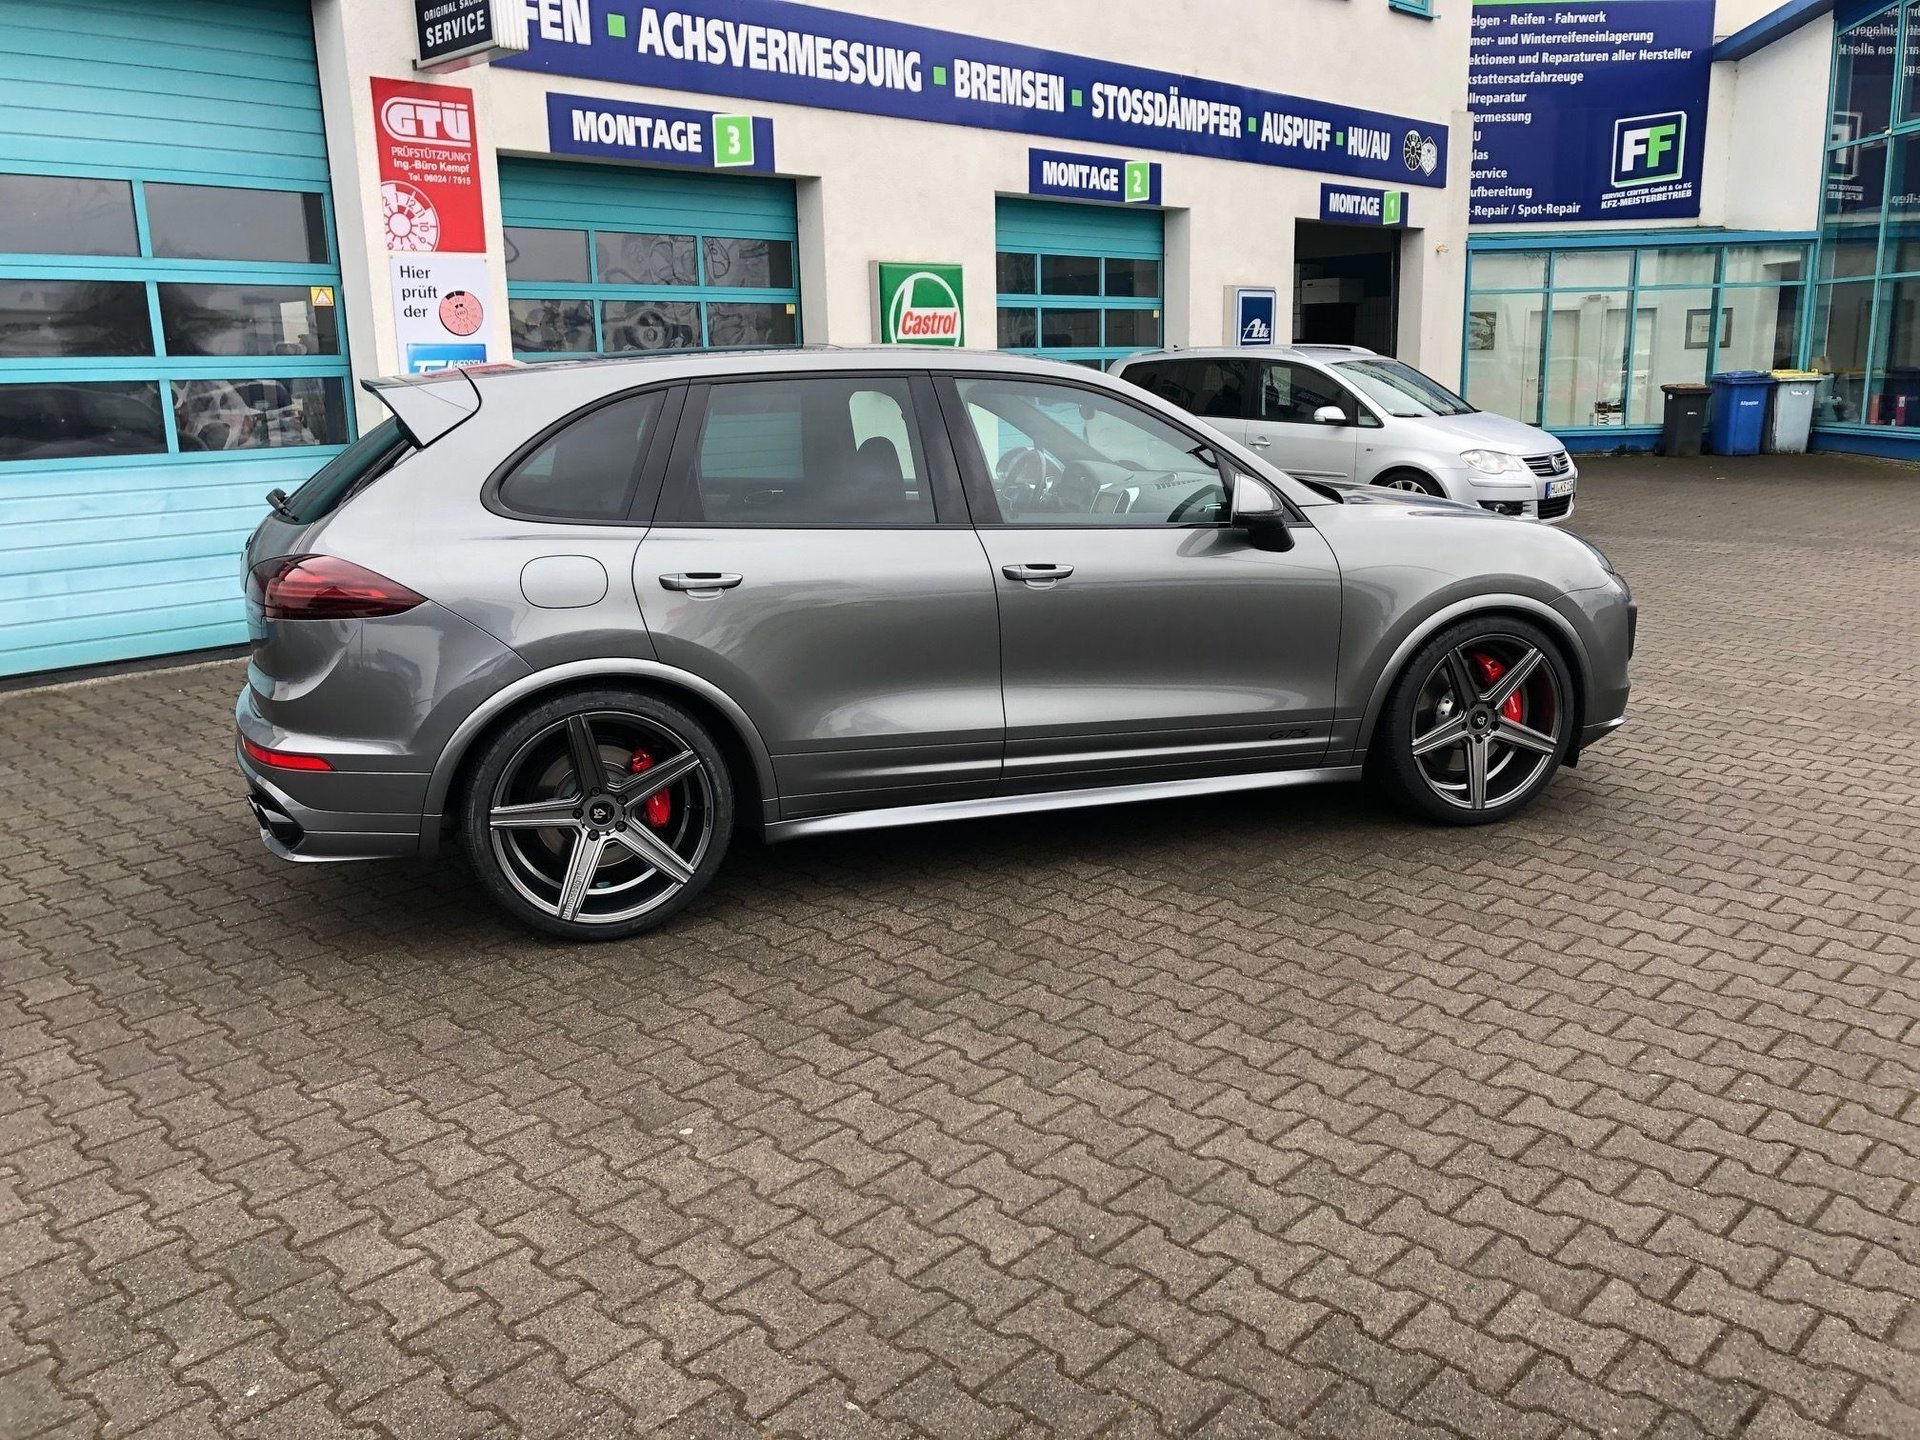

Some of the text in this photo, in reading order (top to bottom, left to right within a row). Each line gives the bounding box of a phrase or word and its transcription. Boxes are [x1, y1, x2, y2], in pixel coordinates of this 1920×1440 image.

[424, 0, 482, 22] ORIGINAL SAC
[1510, 13, 1545, 25] Reifen
[1555, 11, 1606, 24] Fahrwerk
[426, 10, 486, 48] SERVICE
[1498, 33, 1518, 45] und
[1521, 30, 1654, 45] Winterreifeneinlagerung
[1518, 52, 1539, 64] und
[1542, 50, 1609, 66] Reparaturen
[1612, 49, 1637, 62] aller
[1639, 48, 1692, 61] Hersteller
[638, 7, 922, 93] ACHSVERMESSUNG
[954, 58, 1064, 112] BREMSEN
[1092, 82, 1242, 138] STOSSDÄMPFER
[1261, 111, 1331, 152] AUSPUFF
[1348, 126, 1390, 161] HU/AU
[1468, 92, 1527, 106] llreparatur
[386, 100, 471, 142] GTÜ
[1474, 112, 1532, 124] ermessung
[572, 109, 740, 155] MONTAGE 3
[1472, 131, 1482, 141] U
[391, 146, 472, 162] PRÜFSTÜTZPUNKT
[1472, 149, 1488, 160] las
[394, 158, 438, 170] Ing.-Büro
[1042, 160, 1141, 192] MONTAGE 2
[1470, 186, 1532, 199] ufbereitung
[1601, 189, 1692, 209] KFZ-MEISTERBETRIEB
[1602, 192, 1626, 200] SERVICE
[1329, 192, 1394, 218] MONTAGE 1
[1518, 202, 1581, 218] Spot-Repair
[400, 265, 431, 279] Hier
[402, 285, 438, 301] prüft
[404, 304, 428, 318] der
[902, 311, 957, 335] Castrol
[1269, 728, 1311, 740] GTS
